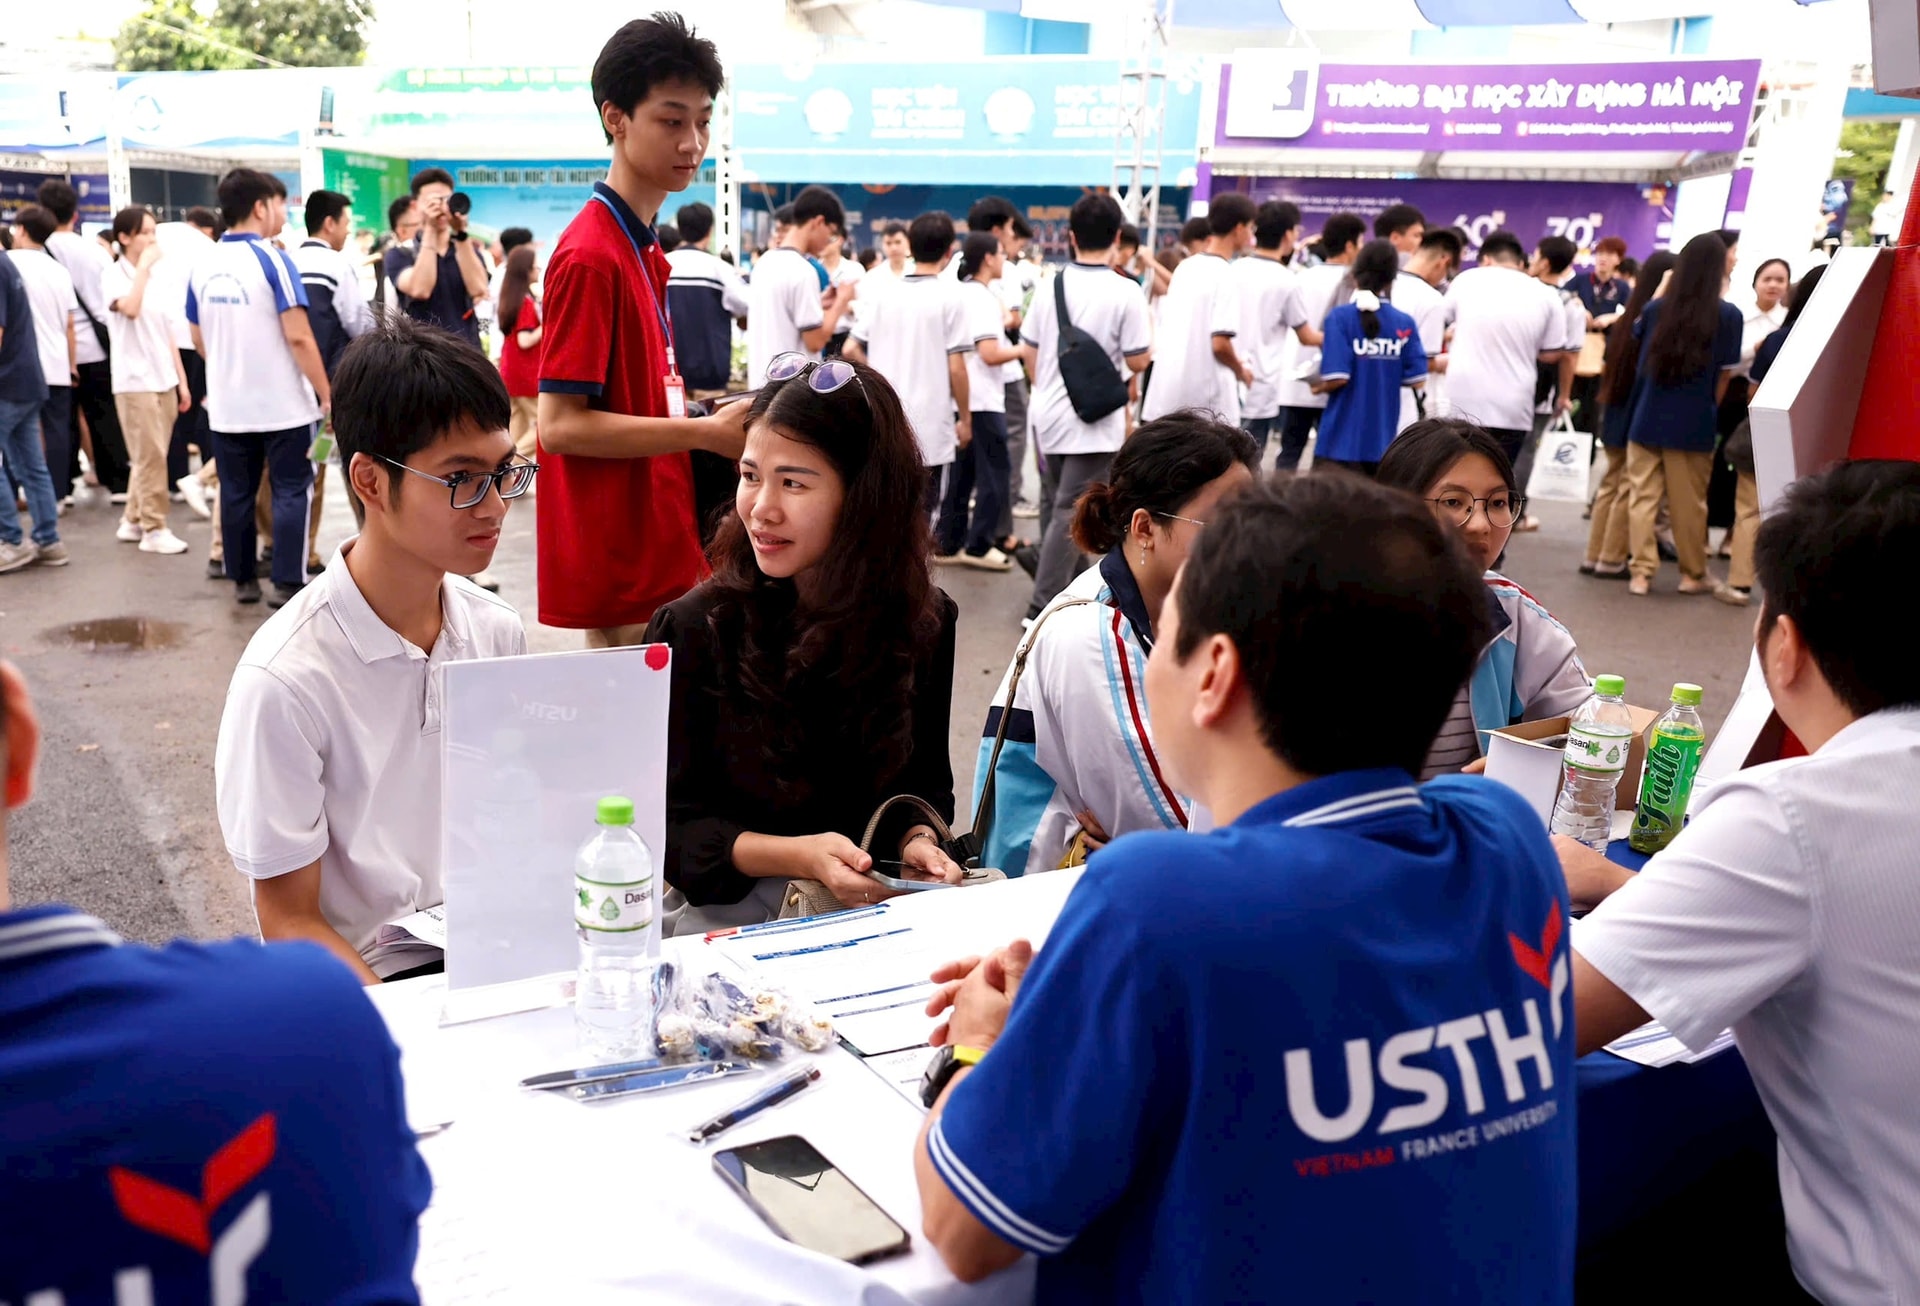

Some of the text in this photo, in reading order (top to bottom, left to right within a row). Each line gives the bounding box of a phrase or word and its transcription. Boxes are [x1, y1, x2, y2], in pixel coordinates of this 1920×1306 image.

[1326, 75, 1744, 113] TRƯỜNG ĐẠI HỌC XÂY DỰNG HÀ NỘI
[1352, 337, 1402, 356] USTH
[1638, 744, 1681, 828] Faith
[1284, 998, 1554, 1142] USTH
[1294, 1146, 1395, 1177] VIETNAM
[1401, 1127, 1479, 1161] FRANCE
